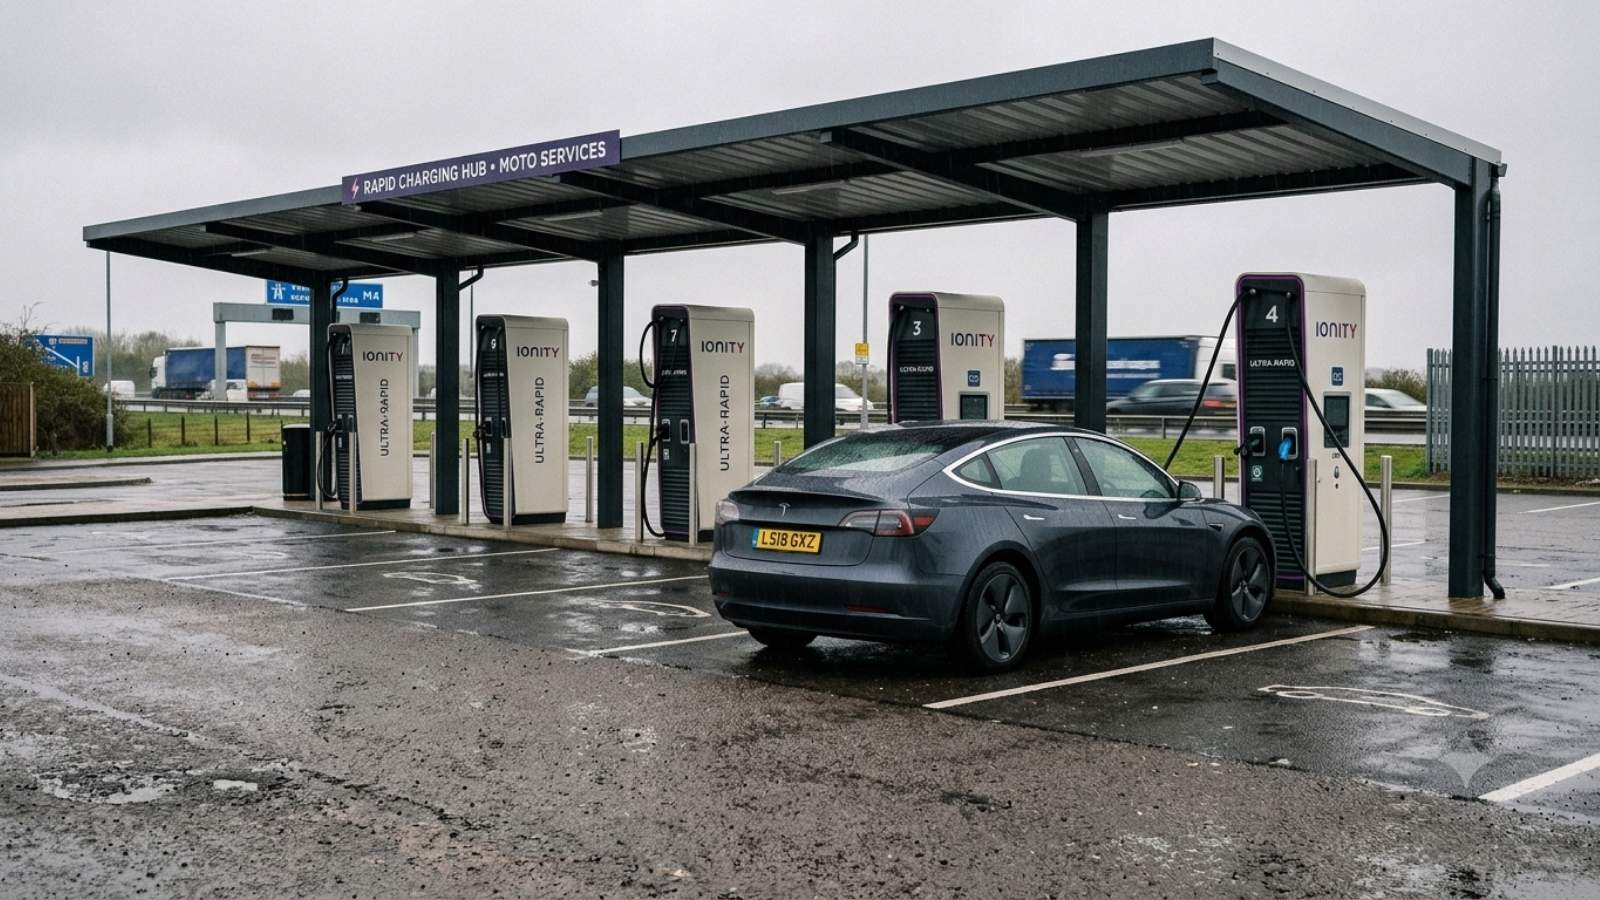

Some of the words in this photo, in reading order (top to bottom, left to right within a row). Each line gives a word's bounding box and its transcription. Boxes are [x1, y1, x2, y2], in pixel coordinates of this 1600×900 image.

[363, 176, 396, 195] RAPID
[398, 166, 458, 190] CHARGING
[461, 160, 487, 179] HUB
[499, 152, 537, 174] MOTO
[540, 140, 606, 167] SERVICES
[1265, 305, 1279, 323] 4
[670, 329, 678, 343] 7
[912, 320, 922, 336] 3
[1315, 321, 1357, 339] IONITY
[701, 340, 745, 354] IONITY
[951, 332, 995, 347] IONITY
[362, 351, 404, 362] IONITY
[516, 345, 560, 358] IONITY
[534, 376, 545, 464] ULTRA-RAPID
[720, 375, 730, 472] ULTRA-RAPID
[762, 531, 788, 546] LS18
[790, 533, 816, 548] GXZ
